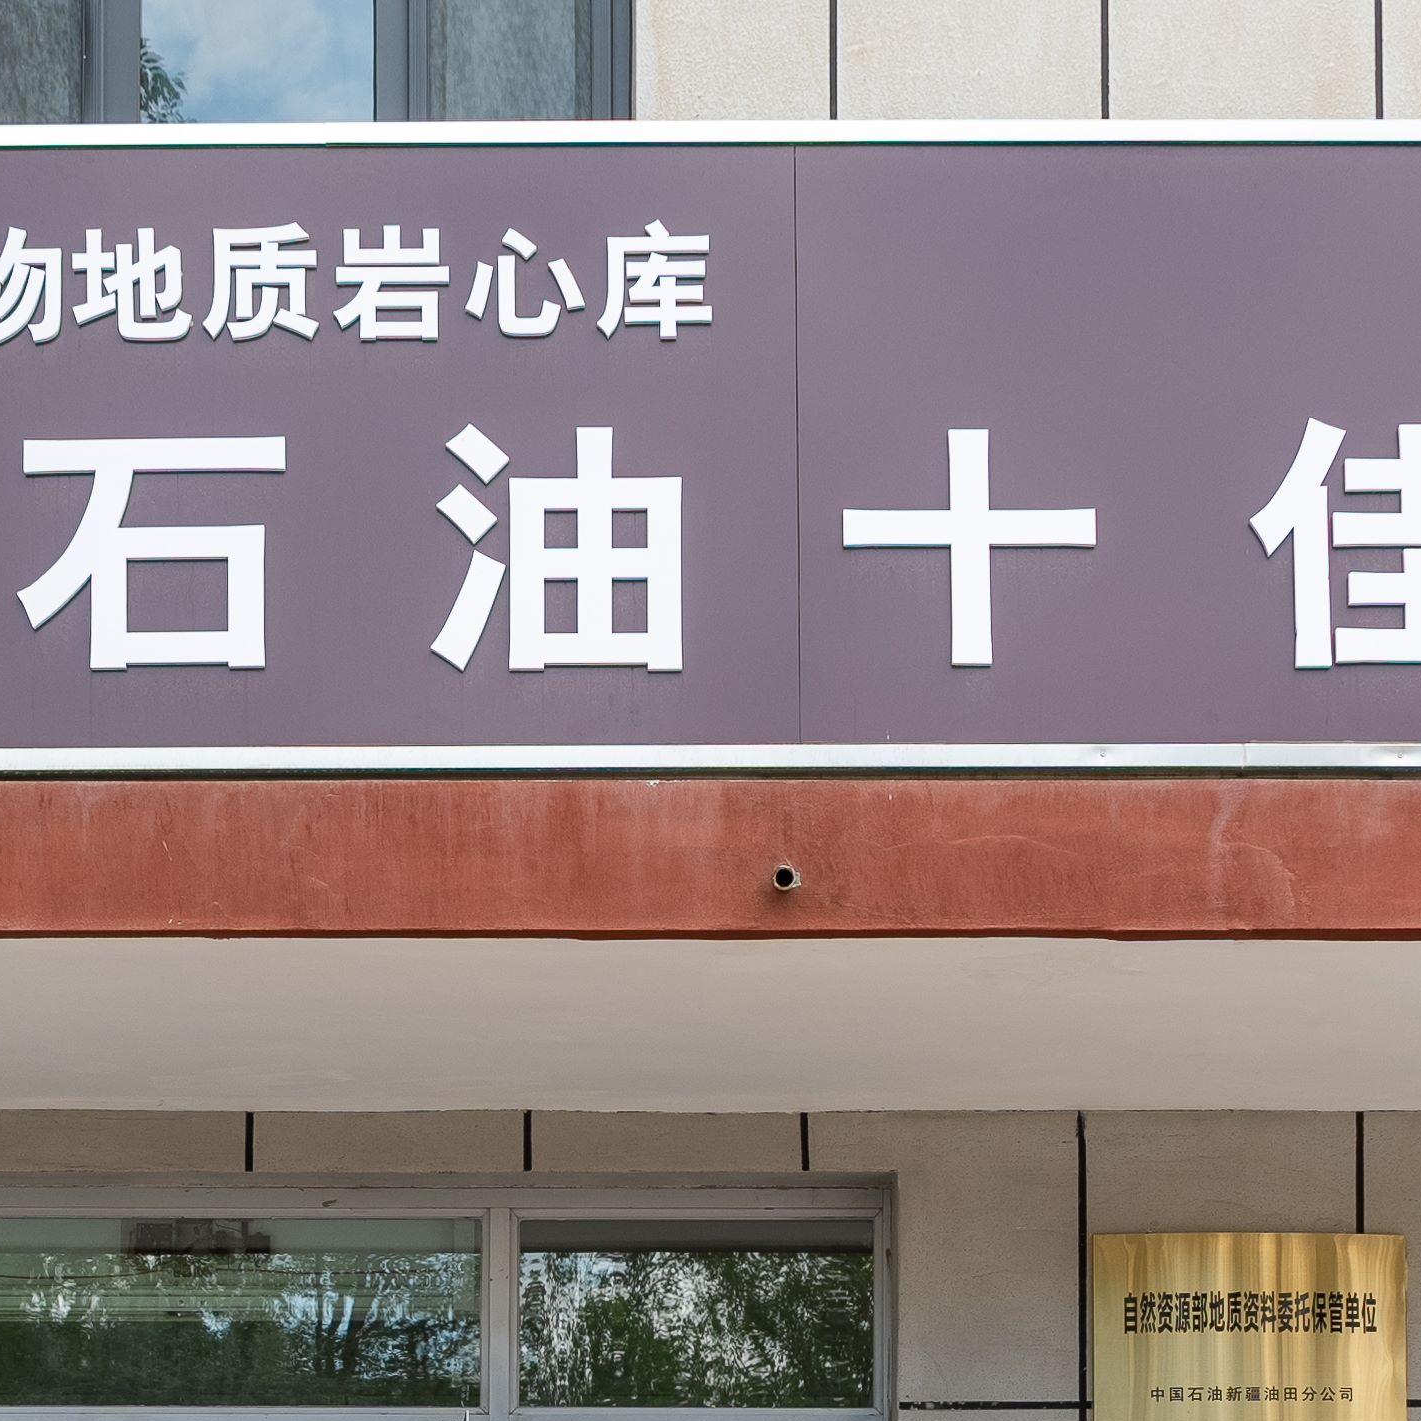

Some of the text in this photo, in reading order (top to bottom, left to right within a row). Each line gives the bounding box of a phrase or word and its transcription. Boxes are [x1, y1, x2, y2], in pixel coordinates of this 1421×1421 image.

[1123, 1290, 1378, 1335] 自然资源部地质资料委托保管单位
[1150, 1385, 1354, 1403] 中国石油新疆油田分公司
